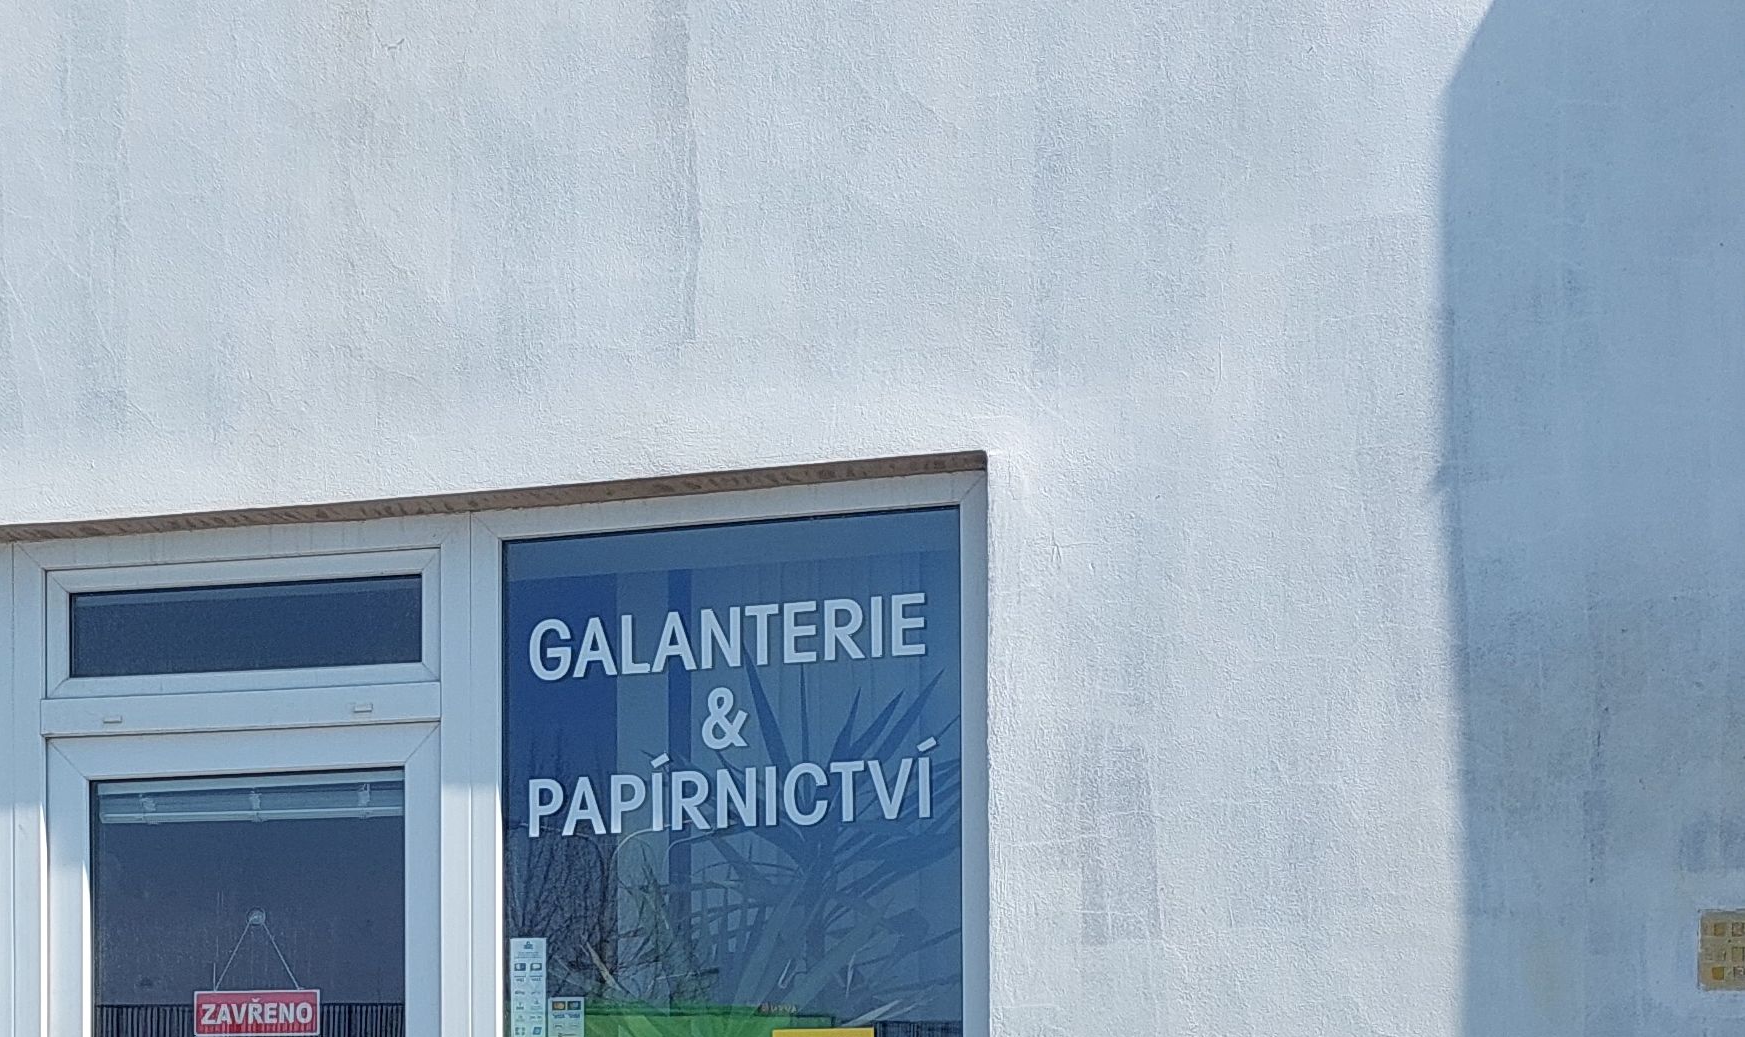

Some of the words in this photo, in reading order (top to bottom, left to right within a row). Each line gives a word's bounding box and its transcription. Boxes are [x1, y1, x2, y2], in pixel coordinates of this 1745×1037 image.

[529, 592, 926, 681] GALANTERIE
[701, 687, 748, 750] &
[528, 736, 937, 838] PAPÍRNICTVÍ
[201, 998, 313, 1025] ZAVŘENO
